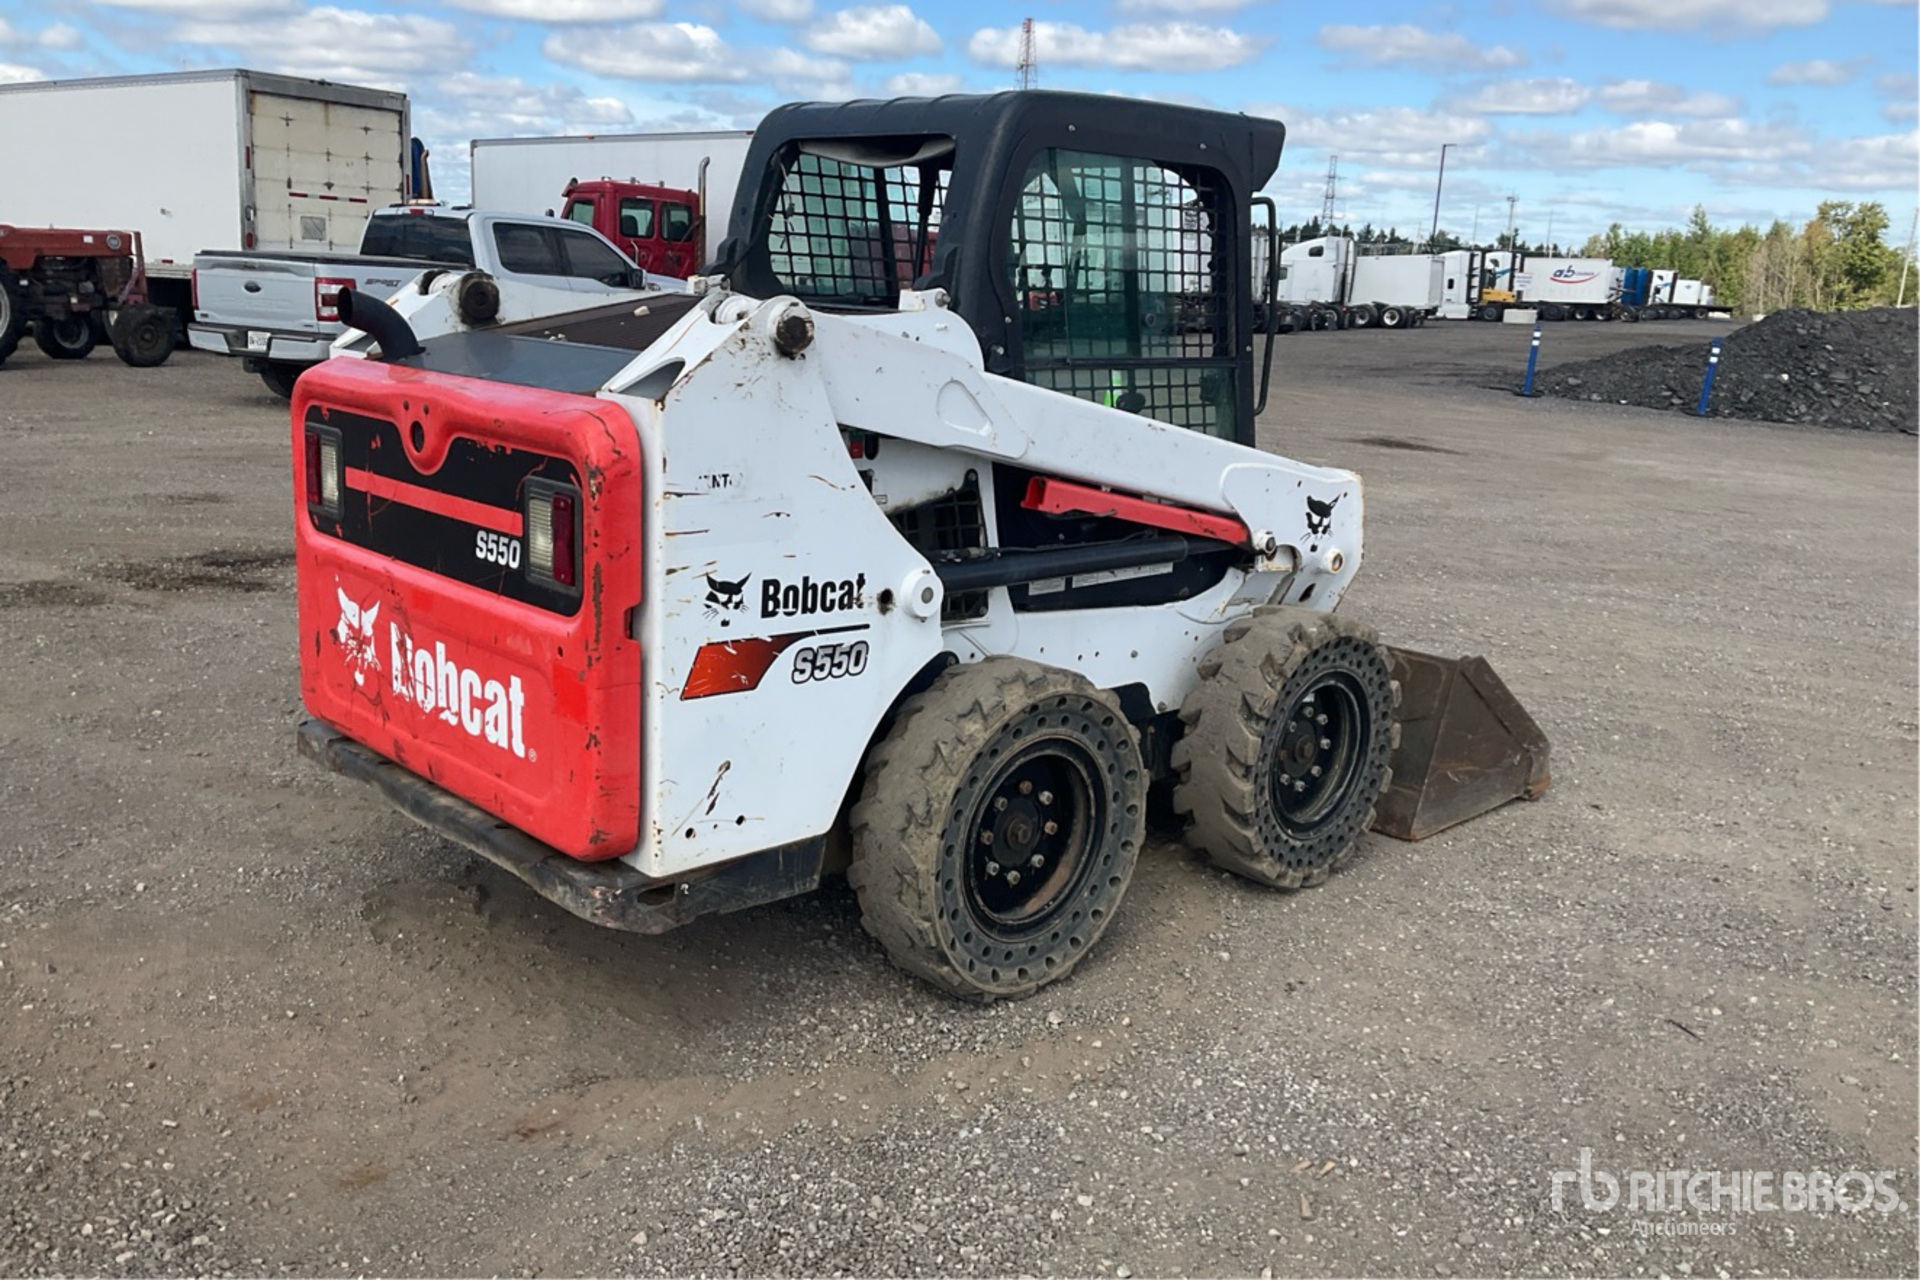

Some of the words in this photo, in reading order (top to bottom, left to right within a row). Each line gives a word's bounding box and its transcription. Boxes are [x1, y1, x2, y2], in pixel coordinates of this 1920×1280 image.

[475, 530, 521, 569] S550
[761, 573, 866, 619] Bobcat
[791, 640, 869, 685] S550
